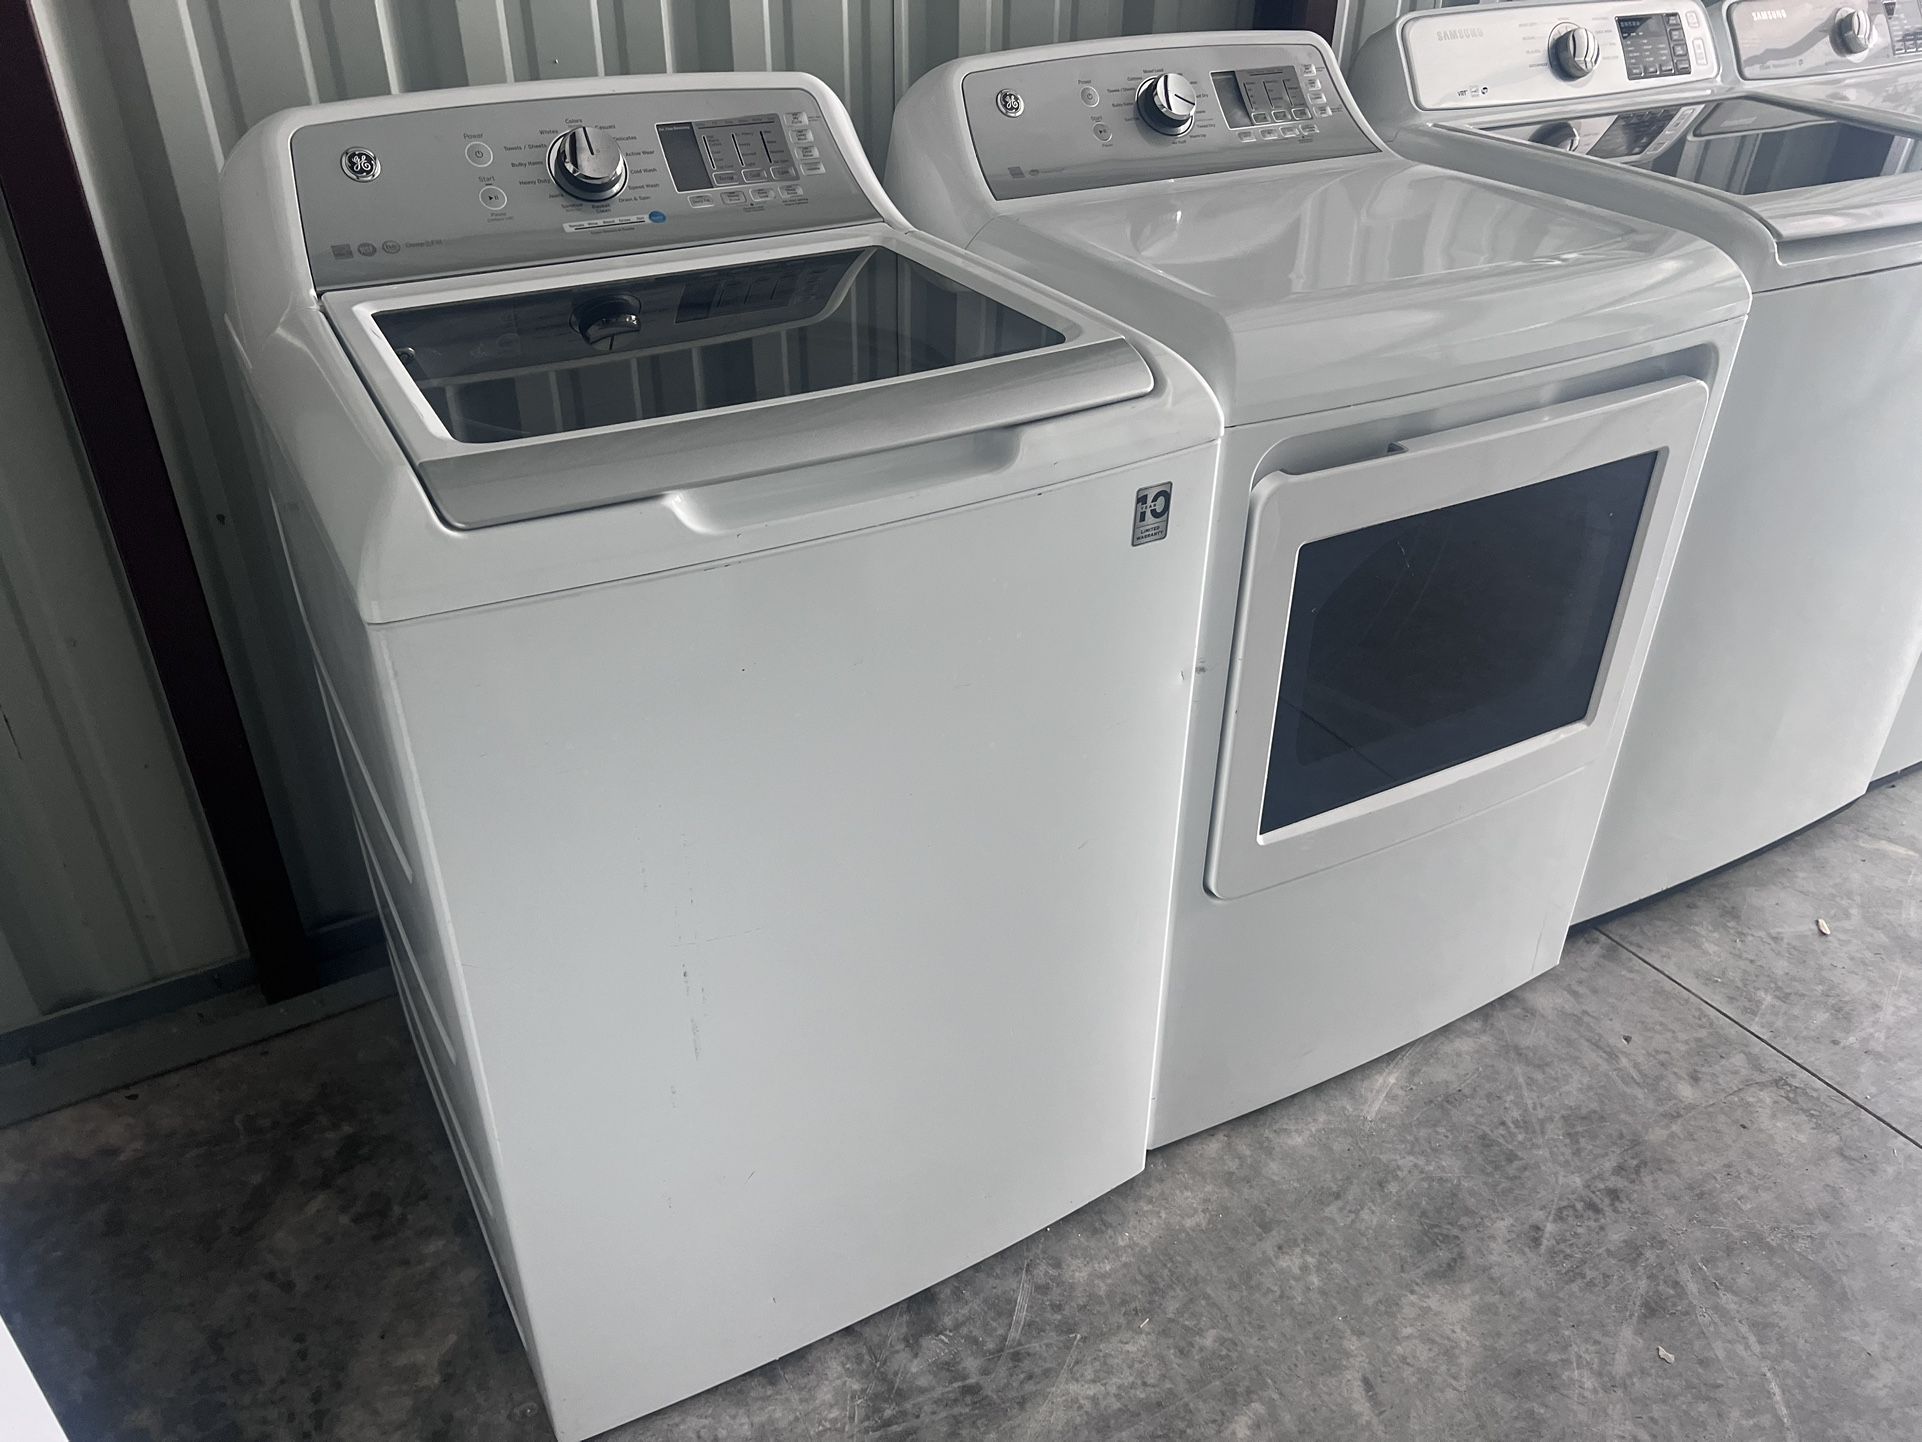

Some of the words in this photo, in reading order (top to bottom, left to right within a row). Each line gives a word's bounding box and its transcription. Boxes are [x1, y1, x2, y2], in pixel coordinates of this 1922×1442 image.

[1752, 9, 1787, 21] SAMSUNG
[1437, 28, 1484, 41] SAMSUNG
[463, 132, 484, 140] Power
[478, 175, 496, 183] Start
[519, 179, 536, 187] Heavy
[536, 178, 551, 186] Duty
[1136, 490, 1171, 523] 10
[1140, 525, 1160, 535] LIMITED
[1136, 530, 1164, 541] WARRANTY
